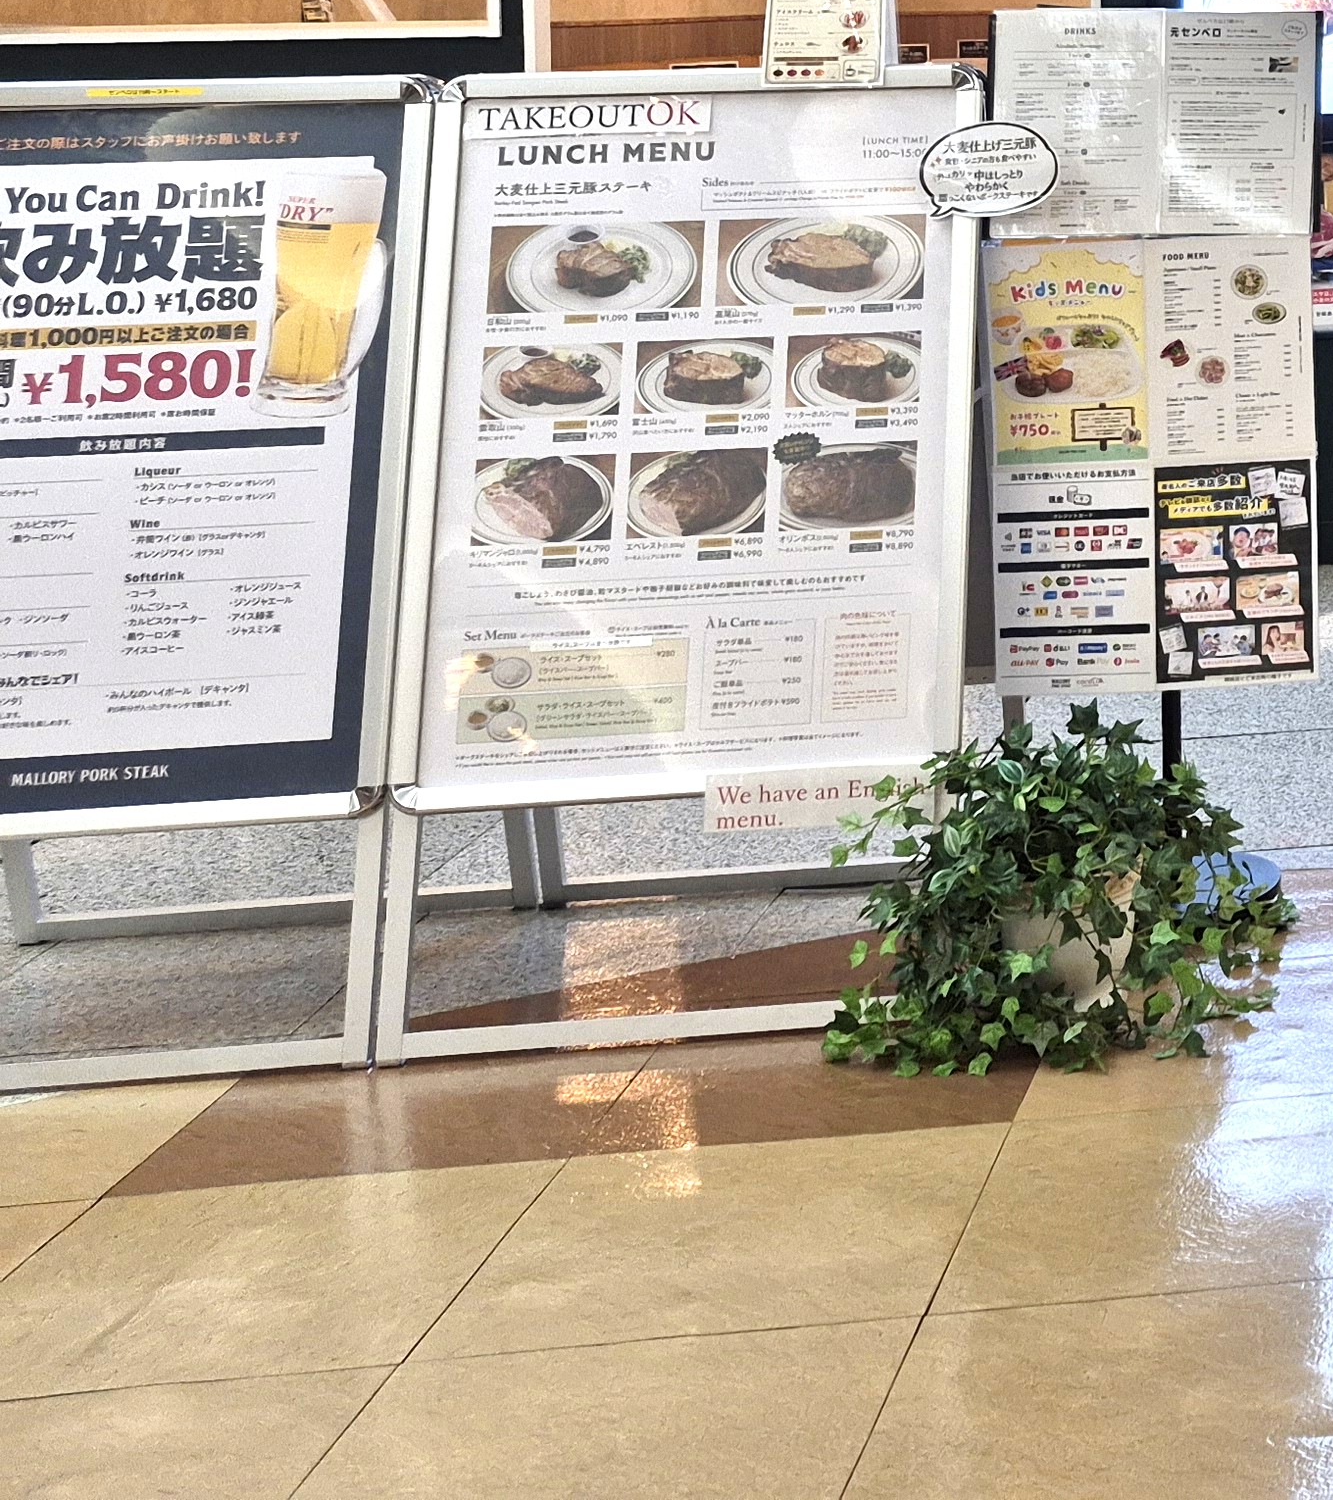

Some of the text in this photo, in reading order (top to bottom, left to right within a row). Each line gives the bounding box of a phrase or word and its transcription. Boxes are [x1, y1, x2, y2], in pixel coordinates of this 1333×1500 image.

[1064, 27, 1097, 36] DRINKS
[1170, 27, 1222, 38] 元センベロ
[479, 100, 701, 131] TAKEOUTOK
[497, 140, 716, 167] LUNCH MENU
[702, 177, 729, 188] Sides
[495, 180, 653, 198] 大麦仕上三元豚ステーキ
[5, 180, 266, 214] You Can Drink!
[1163, 253, 1184, 261] FOOD
[1010, 278, 1123, 303] Kids Menu
[155, 286, 258, 316] ¥1,680
[828, 305, 856, 315] ¥1,290
[895, 303, 923, 312] ¥1,390
[600, 313, 629, 323] ¥1,090
[671, 311, 699, 321] ¥1,190
[21, 349, 257, 408] ¥1,580!
[890, 406, 919, 416] ¥3,390
[742, 412, 771, 422] ¥2,090
[590, 419, 618, 428] ¥1,690
[889, 418, 919, 428] ¥3,490
[740, 425, 768, 435] ¥2,190
[1010, 424, 1050, 437] ¥750
[589, 431, 618, 441] ¥1,790
[79, 437, 167, 453] 飲み放題内容
[134, 466, 181, 478] Liqueur
[130, 519, 160, 529] Wine
[886, 529, 914, 539] ¥8,790
[734, 536, 763, 546] ¥6,890
[579, 544, 610, 555] ¥4,790
[885, 542, 914, 552] ¥8,890
[733, 549, 763, 559] ¥6,990
[578, 557, 610, 567] ¥4,890
[124, 571, 185, 583] Softdrink
[718, 617, 728, 628] la
[730, 616, 761, 627] Carte
[464, 629, 517, 642] Set Menu
[11, 764, 169, 787] MALLORY PORK STEAK
[718, 784, 839, 805] We have an
[716, 814, 784, 830] menu.
